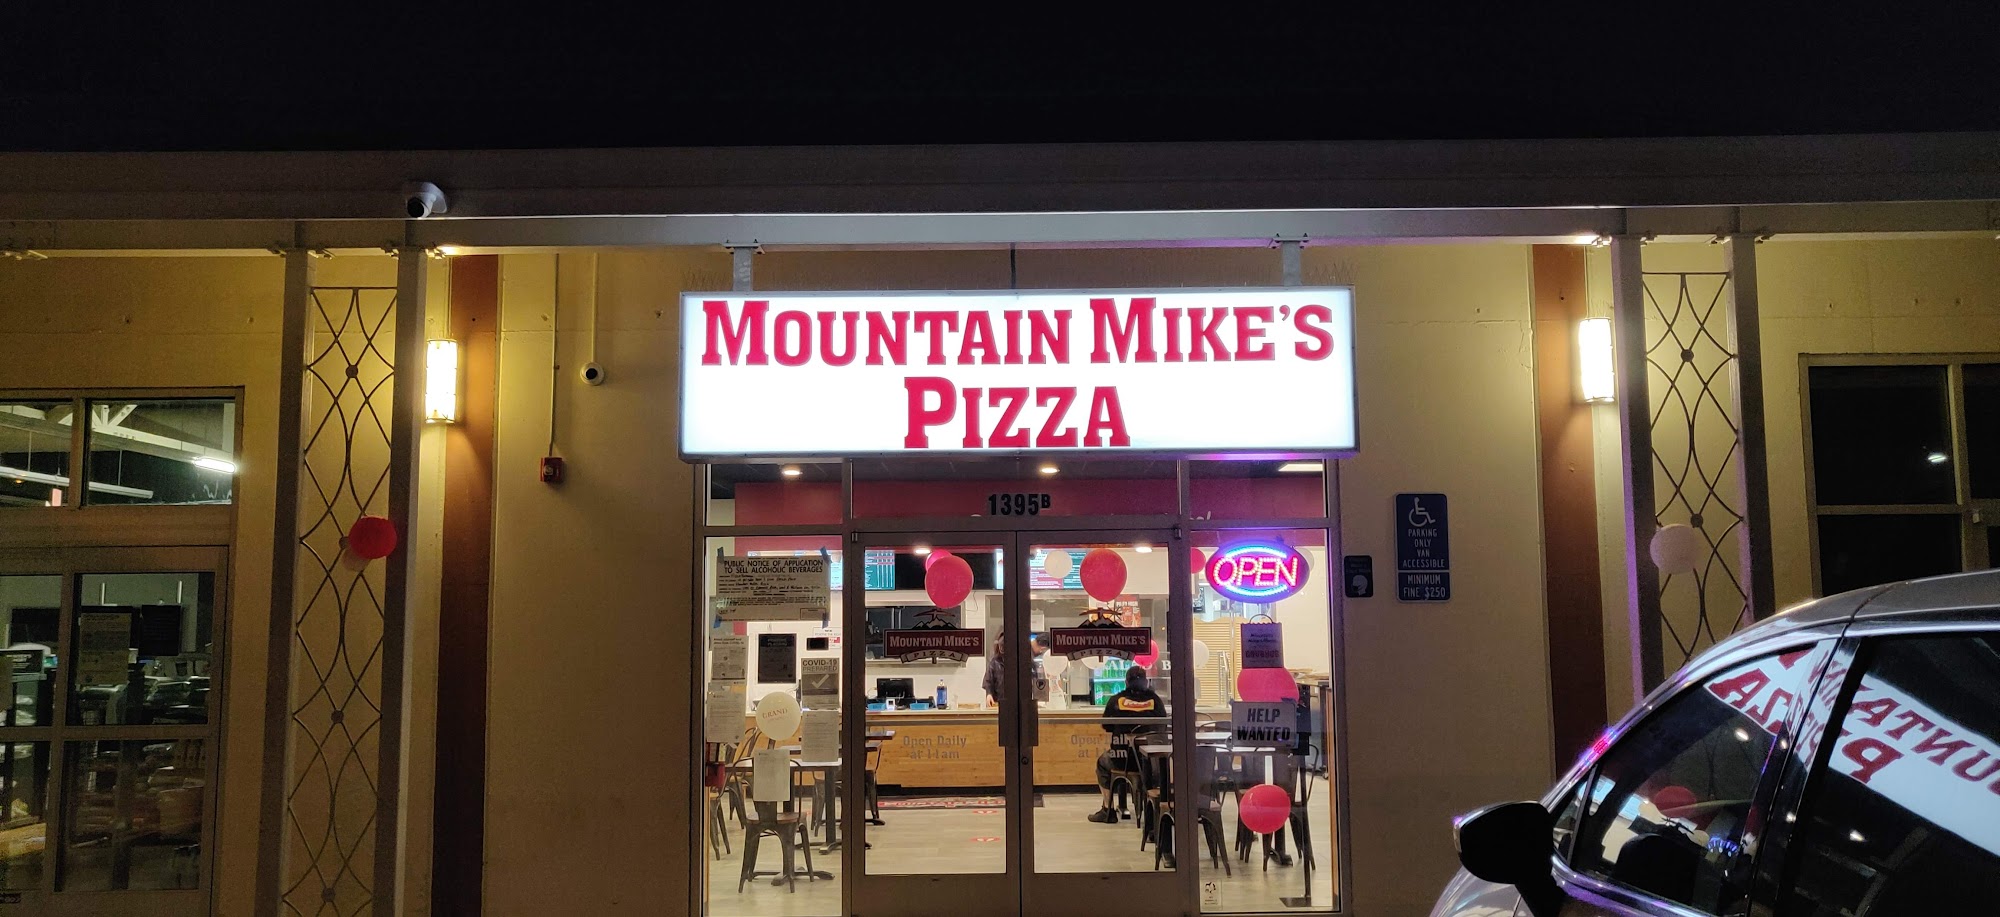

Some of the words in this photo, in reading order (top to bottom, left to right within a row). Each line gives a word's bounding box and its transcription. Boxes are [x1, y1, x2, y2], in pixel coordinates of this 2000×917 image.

[702, 298, 1073, 367] MOUNTAIN
[1089, 296, 1335, 364] MIKE'S
[903, 376, 1131, 449] PIZZA
[1408, 528, 1438, 538] PARKING
[1414, 538, 1432, 548] ONLY
[1416, 549, 1430, 558] VAN
[724, 559, 744, 567] PUBLIC
[772, 559, 781, 567] OF
[784, 559, 823, 567] APPLICATION
[1402, 559, 1445, 568] ACCESSIBLE
[736, 566, 749, 574] SELL
[751, 566, 786, 574] ALCOHOLIC
[788, 565, 823, 573] BEVERAGES
[1212, 556, 1298, 587] OPEN
[1407, 574, 1441, 585] MINIMUM
[1403, 587, 1420, 598] FINE
[1424, 587, 1446, 600] $250
[889, 636, 943, 647] MOUNTAIN
[944, 635, 979, 647] MIKE'S
[1055, 634, 1109, 646] MOUNTAIN
[1111, 634, 1146, 645] MIKE'S
[913, 650, 956, 658] PIZZA
[1080, 649, 1122, 657] PIZZA
[802, 659, 838, 667] COVID-19
[1247, 707, 1281, 723] HELP
[1237, 725, 1291, 741] WANTED
[903, 735, 932, 748] Open
[937, 735, 967, 748] Daily
[1071, 734, 1100, 747] Open
[910, 749, 923, 759] at
[1078, 748, 1090, 758] at
